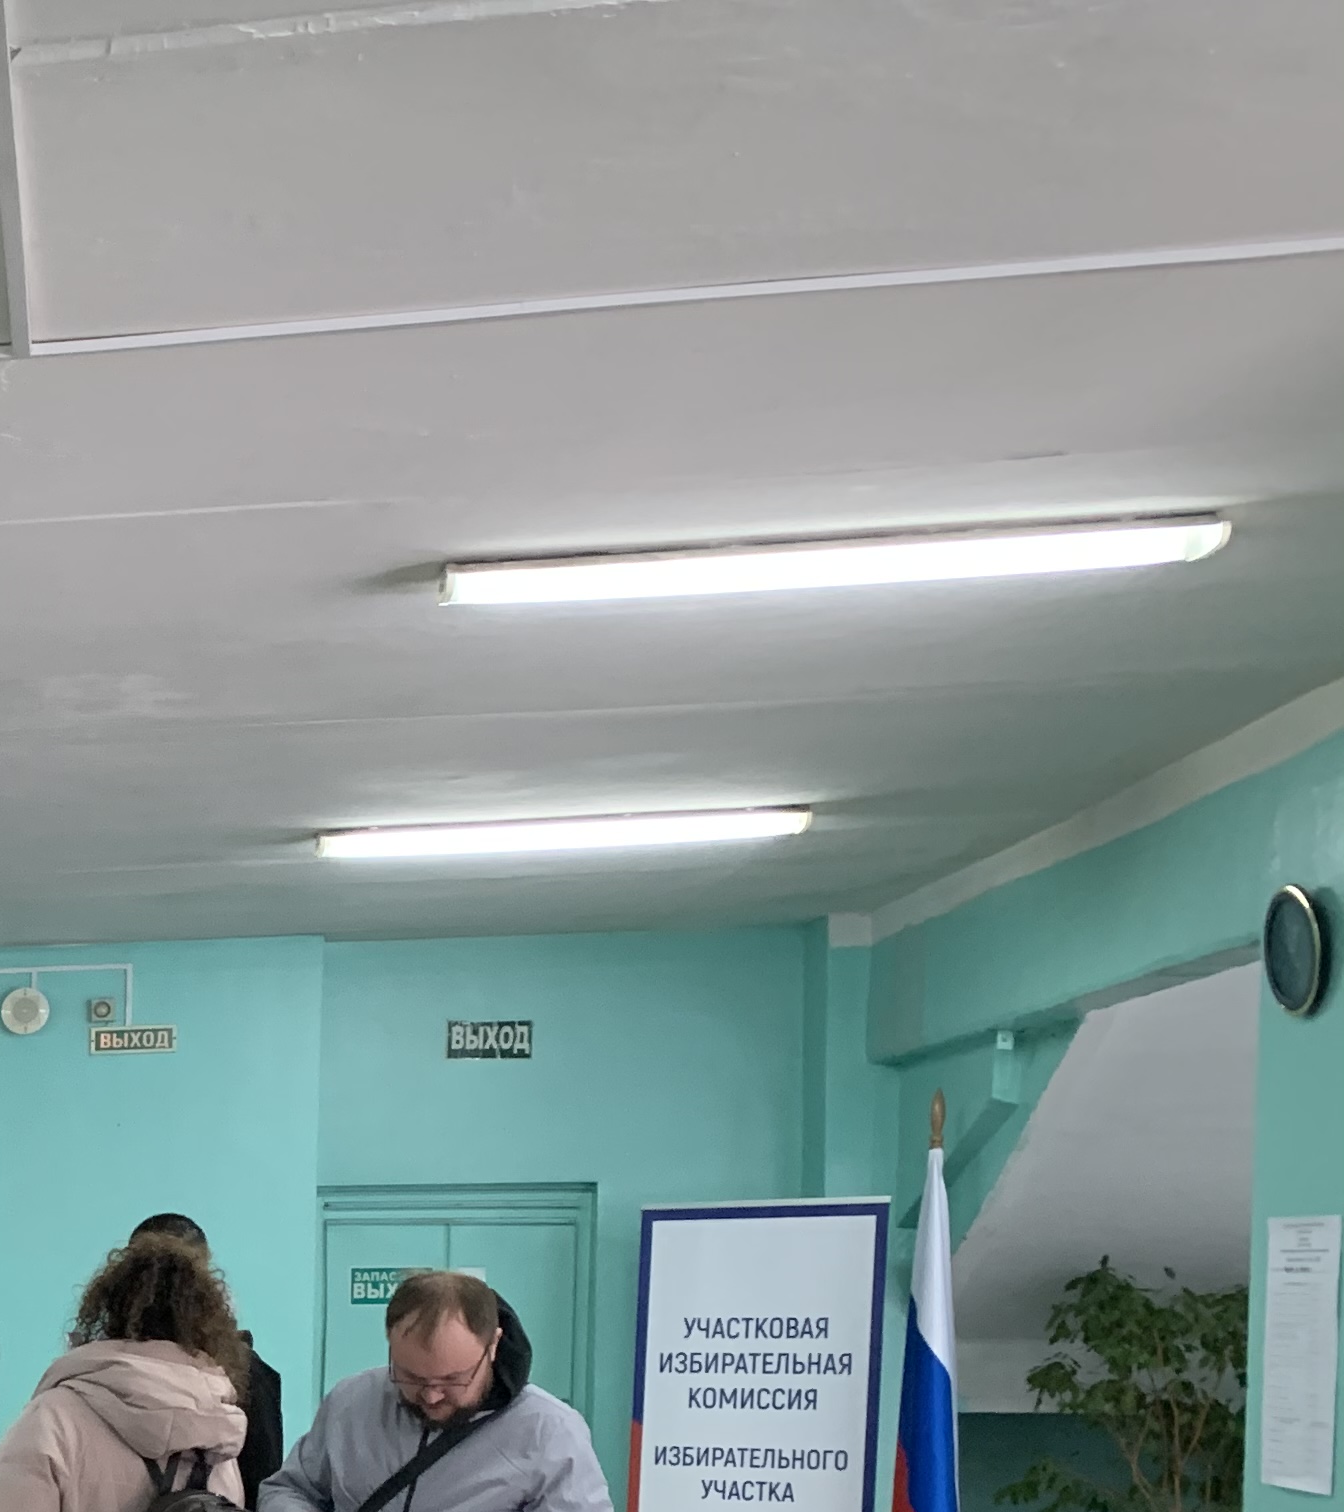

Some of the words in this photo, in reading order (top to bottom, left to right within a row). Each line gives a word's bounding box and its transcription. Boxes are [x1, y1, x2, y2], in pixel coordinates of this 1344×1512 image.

[99, 1030, 169, 1049] ВЫХОД
[451, 1024, 530, 1054] ВЫХОД
[354, 1271, 398, 1282] ЗАПАС
[353, 1282, 399, 1299] ВЫХ
[683, 1316, 829, 1340] УЧАСТКОВАЯ
[659, 1351, 852, 1377] ИЗБИРАТЕЛЬНАЯ
[687, 1386, 818, 1411] КОМИССИЯ
[654, 1445, 849, 1472] ИЗБИРАТЕЛЬНОГО
[700, 1479, 795, 1503] УЧАСТКА
